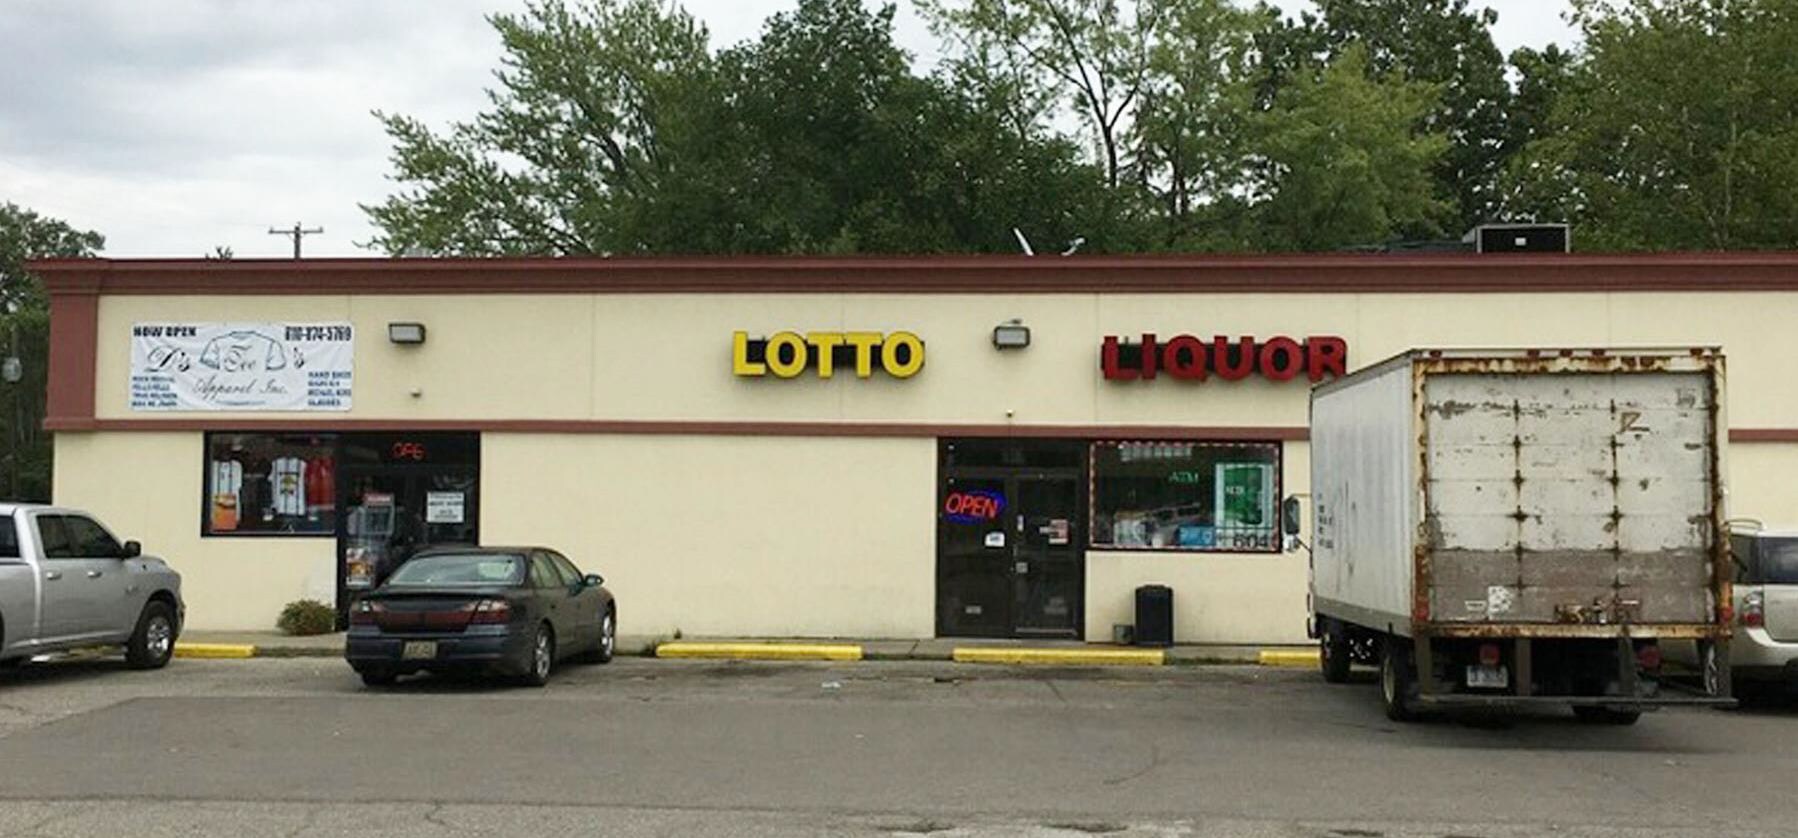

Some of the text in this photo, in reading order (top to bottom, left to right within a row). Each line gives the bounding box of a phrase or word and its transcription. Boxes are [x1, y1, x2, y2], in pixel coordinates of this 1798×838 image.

[133, 326, 197, 337] NOW OPEN
[733, 331, 924, 378] LOTTO
[1101, 334, 1348, 381] LIQUOR
[191, 375, 258, 401] Apparel
[945, 493, 998, 518] OPEN
